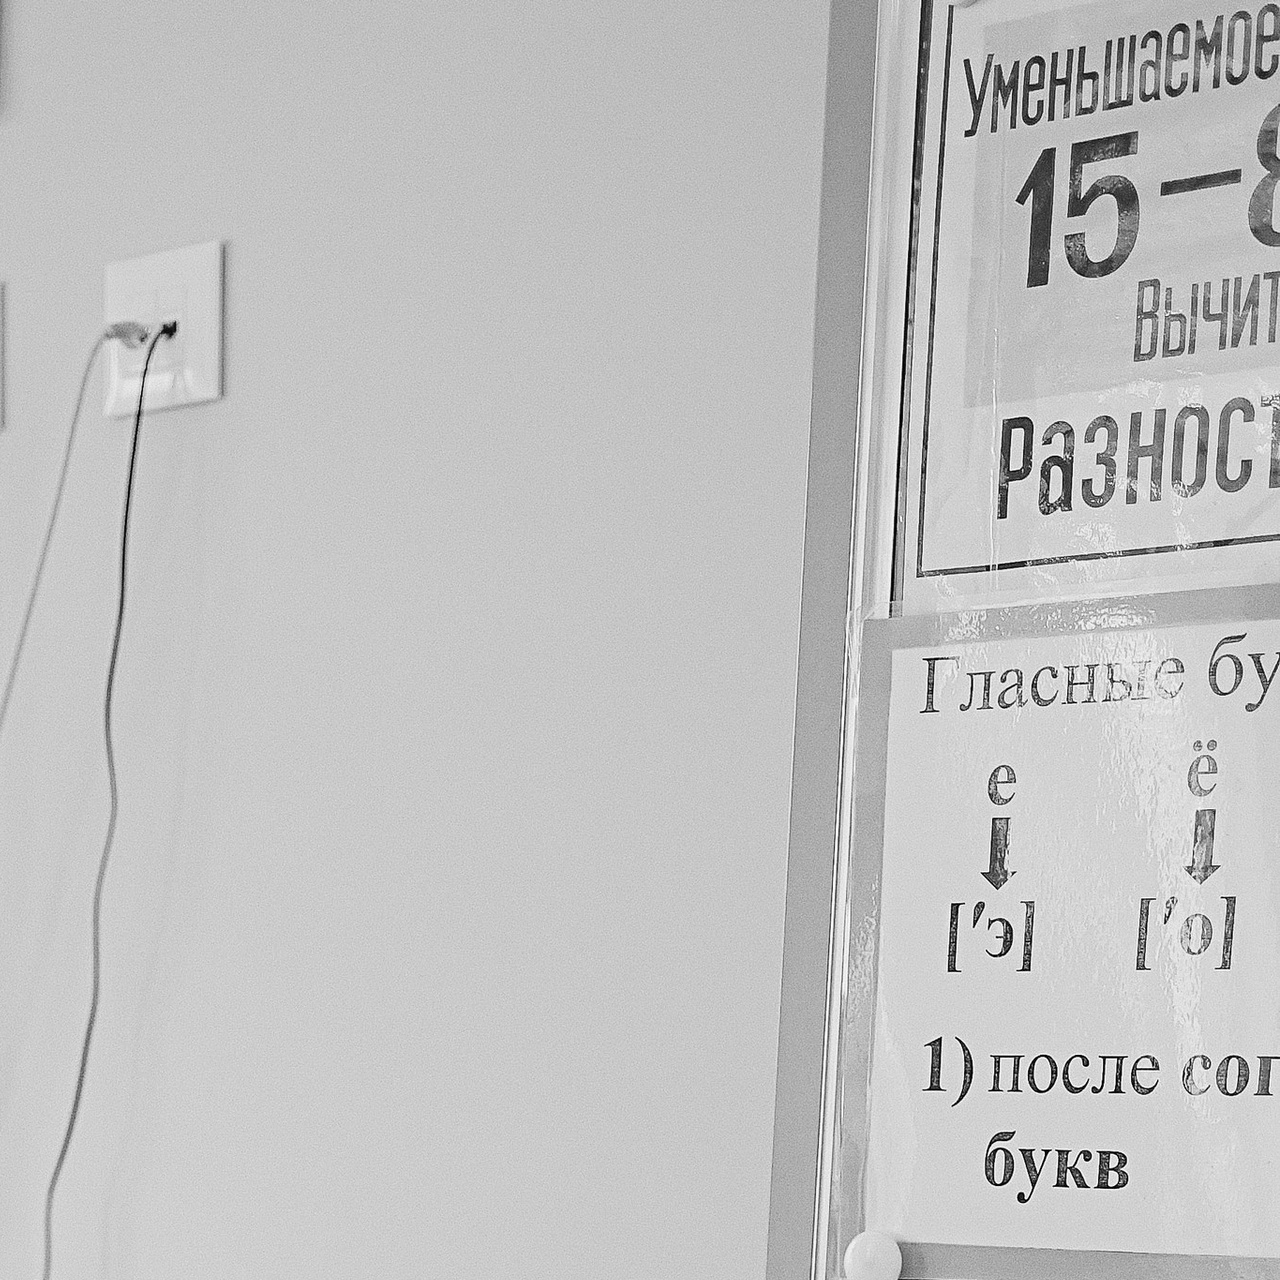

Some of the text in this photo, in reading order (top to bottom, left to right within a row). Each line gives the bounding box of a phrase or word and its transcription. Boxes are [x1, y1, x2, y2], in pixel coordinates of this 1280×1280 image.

[964, 3, 1280, 138] Уменьшаемое
[920, 632, 1280, 715] Гласные бу
[988, 739, 1218, 806] е ё
[922, 1036, 973, 1107] 1)
[988, 1053, 1160, 1097] после
[984, 1131, 1130, 1204] букв
